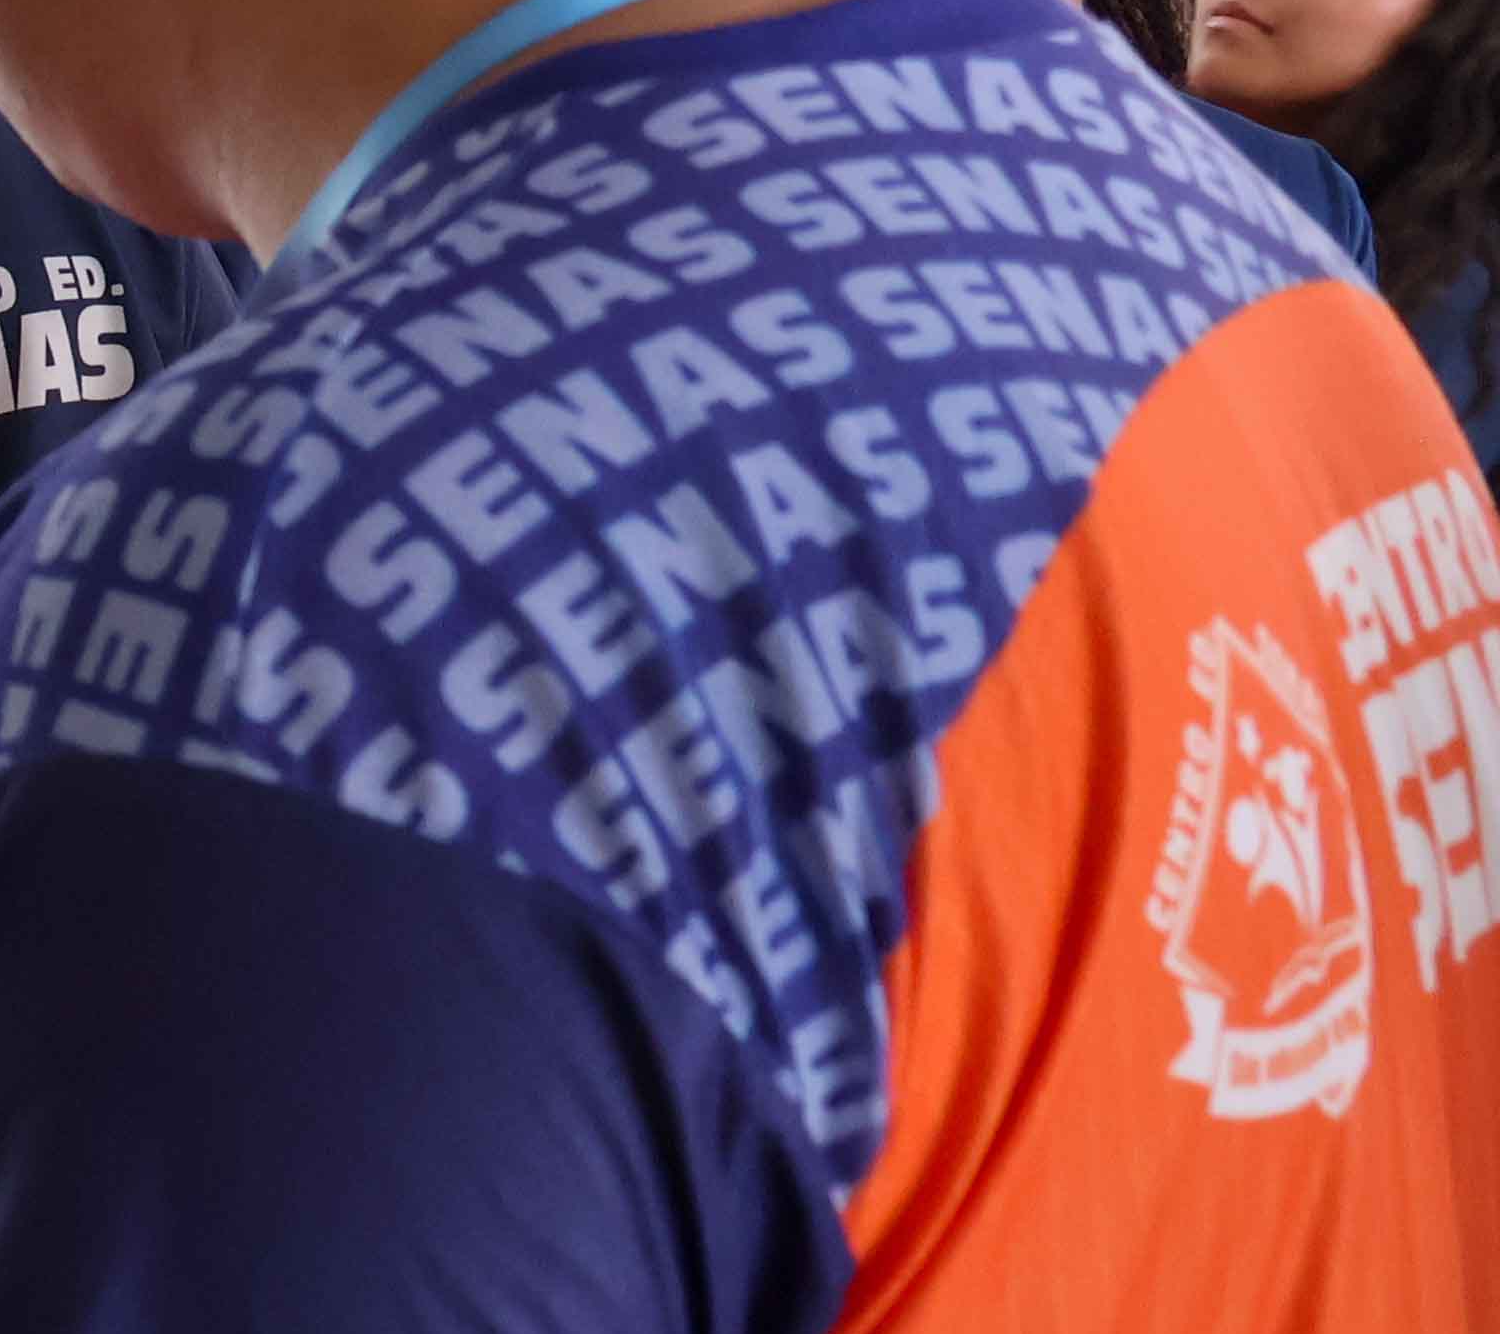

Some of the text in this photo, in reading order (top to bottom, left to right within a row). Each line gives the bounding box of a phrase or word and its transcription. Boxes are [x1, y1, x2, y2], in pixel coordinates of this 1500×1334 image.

[643, 56, 1129, 169] SENAS
[739, 155, 1189, 269] SENAS
[43, 255, 125, 302] ED.
[325, 287, 853, 645] SENAS
[442, 405, 932, 773] SENAS
